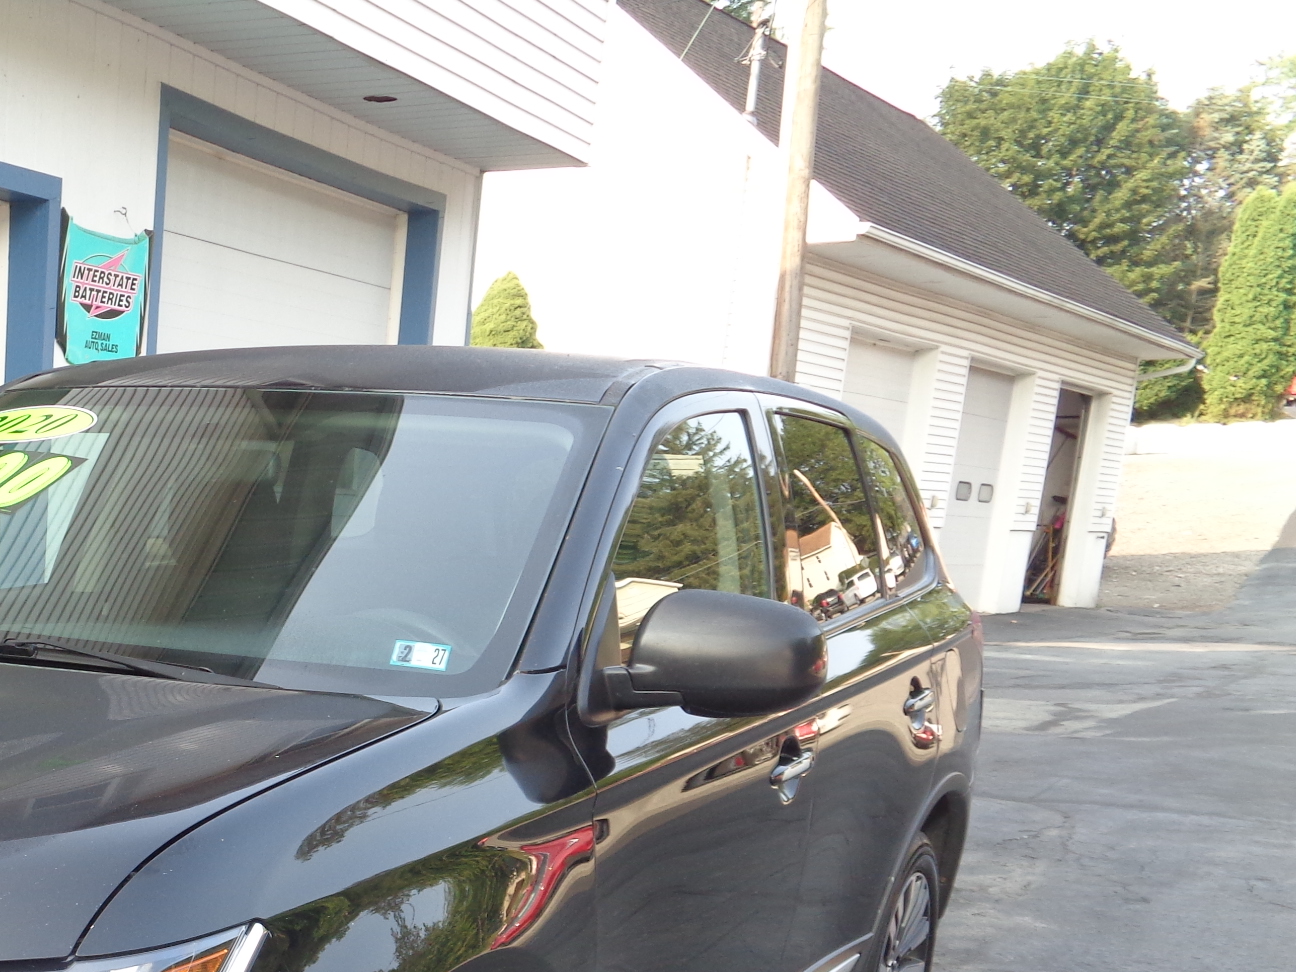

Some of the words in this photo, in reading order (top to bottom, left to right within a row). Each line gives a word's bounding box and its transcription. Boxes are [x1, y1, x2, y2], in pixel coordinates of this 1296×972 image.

[72, 264, 138, 292] INTERSTATE
[73, 284, 132, 309] BATTERIES
[91, 330, 111, 342] EZMAN
[100, 342, 119, 354] SALES
[431, 648, 447, 666] 27
